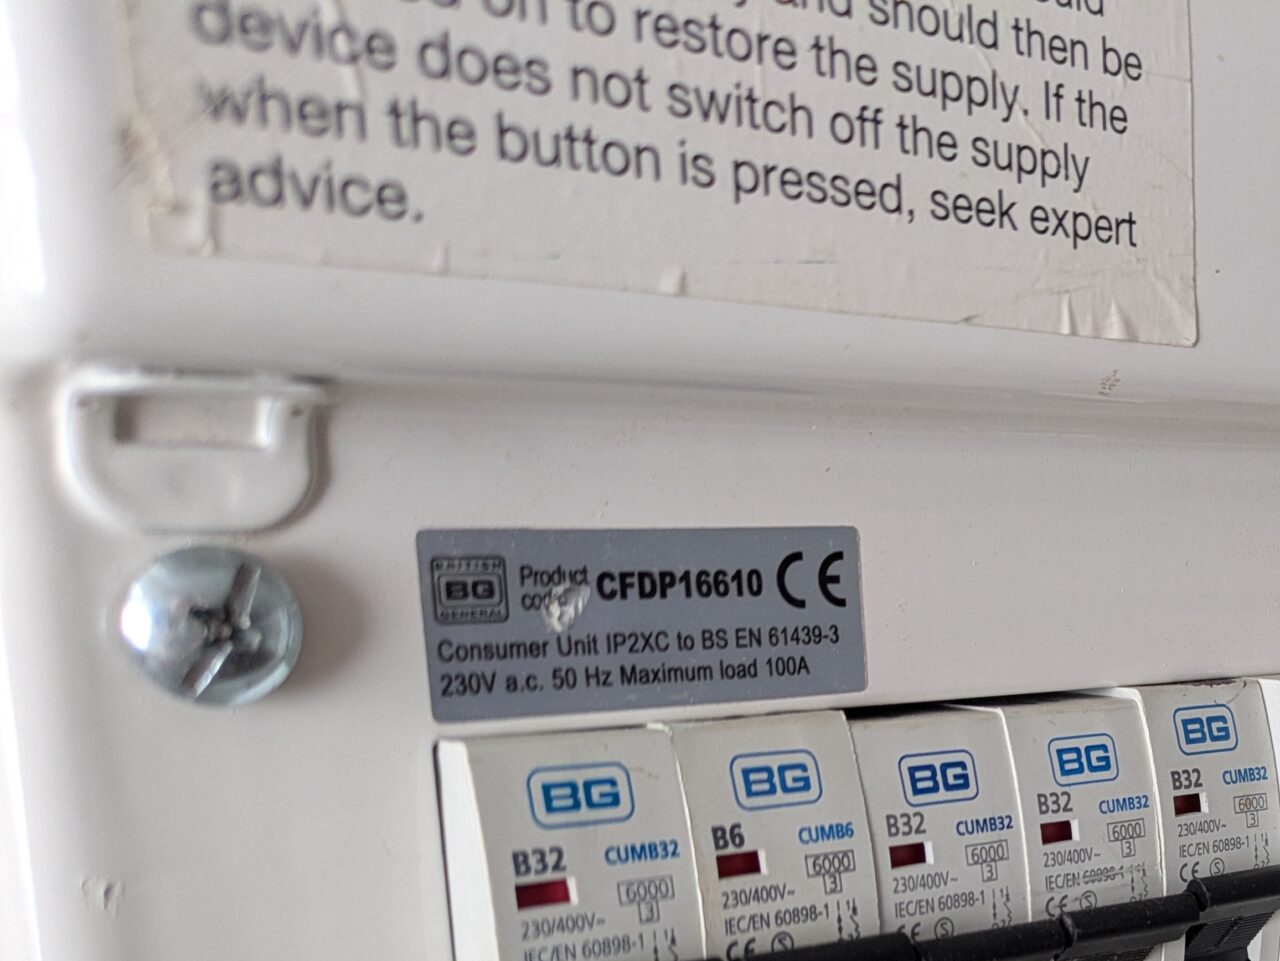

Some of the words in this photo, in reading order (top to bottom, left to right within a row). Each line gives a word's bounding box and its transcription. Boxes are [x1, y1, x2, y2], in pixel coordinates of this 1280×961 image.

[868, 0, 999, 50] should
[1011, 17, 1089, 70] then
[1102, 35, 1143, 81] be
[634, 8, 797, 71] restore
[811, 35, 878, 86] the
[892, 60, 1030, 122] supply.
[1043, 81, 1064, 122] If
[1075, 91, 1128, 134] the
[192, 0, 397, 71] device
[417, 31, 552, 96] does
[571, 64, 652, 111] not
[667, 81, 814, 139] switch
[830, 107, 884, 150] off
[896, 114, 958, 161] the
[971, 134, 1090, 192] supply
[201, 74, 367, 142] when
[387, 97, 477, 157] the
[498, 111, 661, 183] button
[678, 139, 716, 188] is
[732, 158, 915, 223] pressed,
[930, 188, 1019, 231] seek
[1029, 204, 1138, 250] expert
[209, 153, 426, 223] advice.
[445, 580, 495, 600] BG
[519, 564, 590, 588] Product
[596, 569, 763, 601] CFDP16610
[776, 551, 847, 608] CE
[437, 636, 551, 664] Consumer
[557, 632, 599, 658] Unit
[606, 630, 670, 655] IP2XC
[677, 630, 696, 653] to
[702, 626, 728, 650] BS
[735, 624, 763, 648] EN
[769, 623, 840, 647] 61439-3
[440, 670, 496, 698] 230V
[505, 673, 544, 695] a.c.
[552, 667, 577, 690] 50
[585, 665, 613, 688] Hz
[620, 660, 713, 686] Maximum
[719, 656, 759, 679] load
[765, 655, 811, 678] 100A
[1180, 715, 1231, 746] BG
[1055, 743, 1112, 777] BG
[741, 762, 812, 799] BG
[907, 760, 971, 797] BG
[1170, 768, 1204, 791] B32
[1222, 766, 1269, 785] CUMB32
[541, 777, 621, 814] BG
[1036, 791, 1074, 815] B32
[1098, 794, 1150, 814] CUMB32
[1237, 795, 1266, 812] 6000
[711, 822, 745, 850] B6
[798, 821, 855, 845] CUMB6
[885, 812, 927, 837] B32
[955, 814, 1014, 836] CUMB32
[1112, 822, 1142, 841] 6000
[604, 839, 680, 865] CUMB32
[970, 843, 1006, 864] 6000
[1178, 841, 1211, 858] IEC/EN
[1212, 834, 1251, 853] 60898-1
[512, 846, 567, 877] B32
[812, 852, 851, 875] 6000
[625, 879, 669, 901] 6000
[894, 897, 936, 920] IEC/EN
[938, 889, 986, 912] 60898-1
[724, 911, 772, 936] IEC/EN
[774, 902, 830, 927] 60898-1
[582, 933, 645, 958] 60898-1
